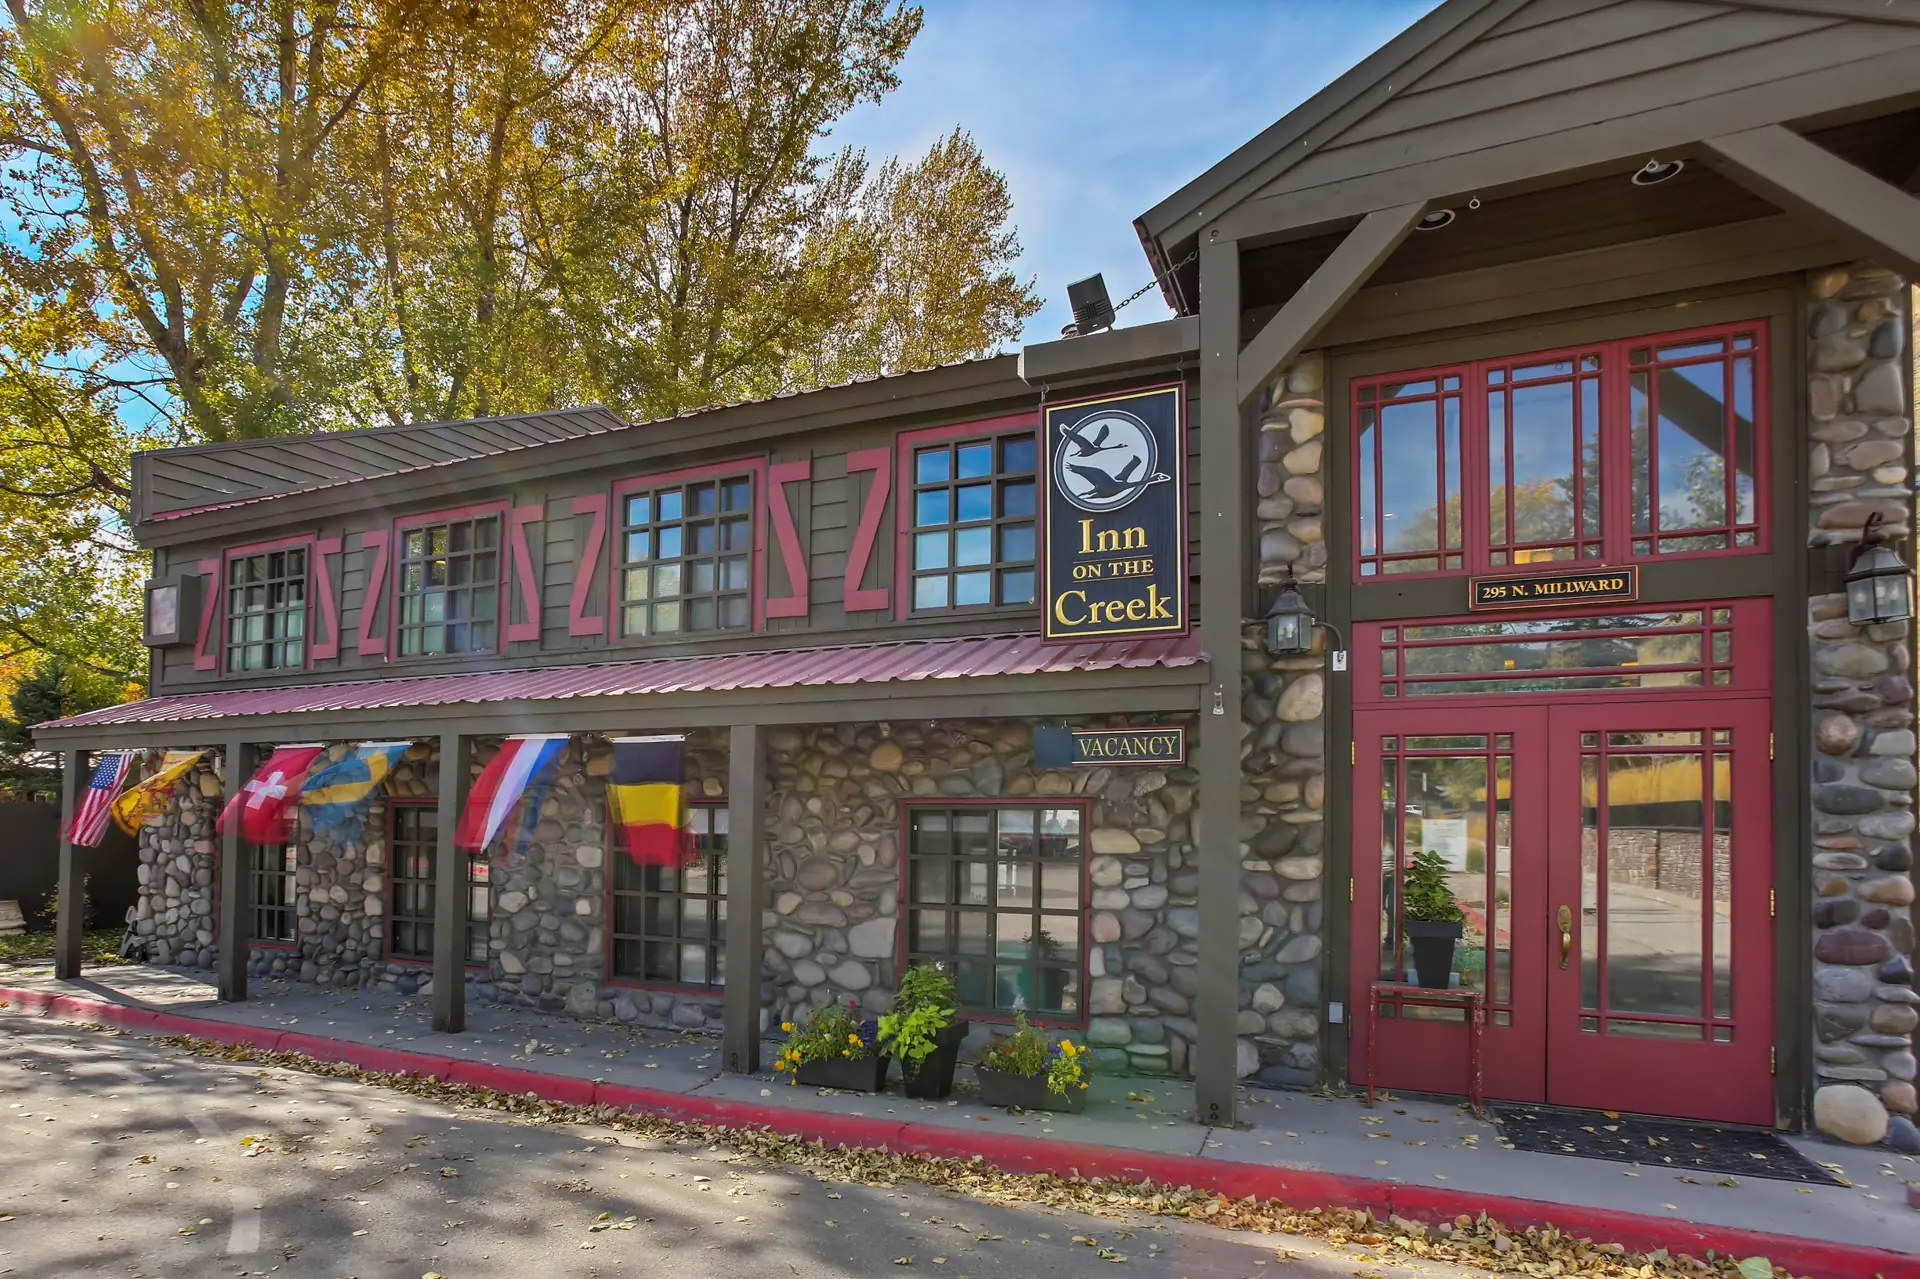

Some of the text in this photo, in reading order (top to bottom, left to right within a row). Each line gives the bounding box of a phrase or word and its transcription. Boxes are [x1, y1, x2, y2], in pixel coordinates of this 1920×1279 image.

[1077, 519, 1149, 554] Inn
[1072, 559, 1155, 580] ON THE
[1483, 579, 1623, 598] 295 N. MILLWARD
[1055, 583, 1174, 626] Creek
[1078, 736, 1178, 757] VACANCY
